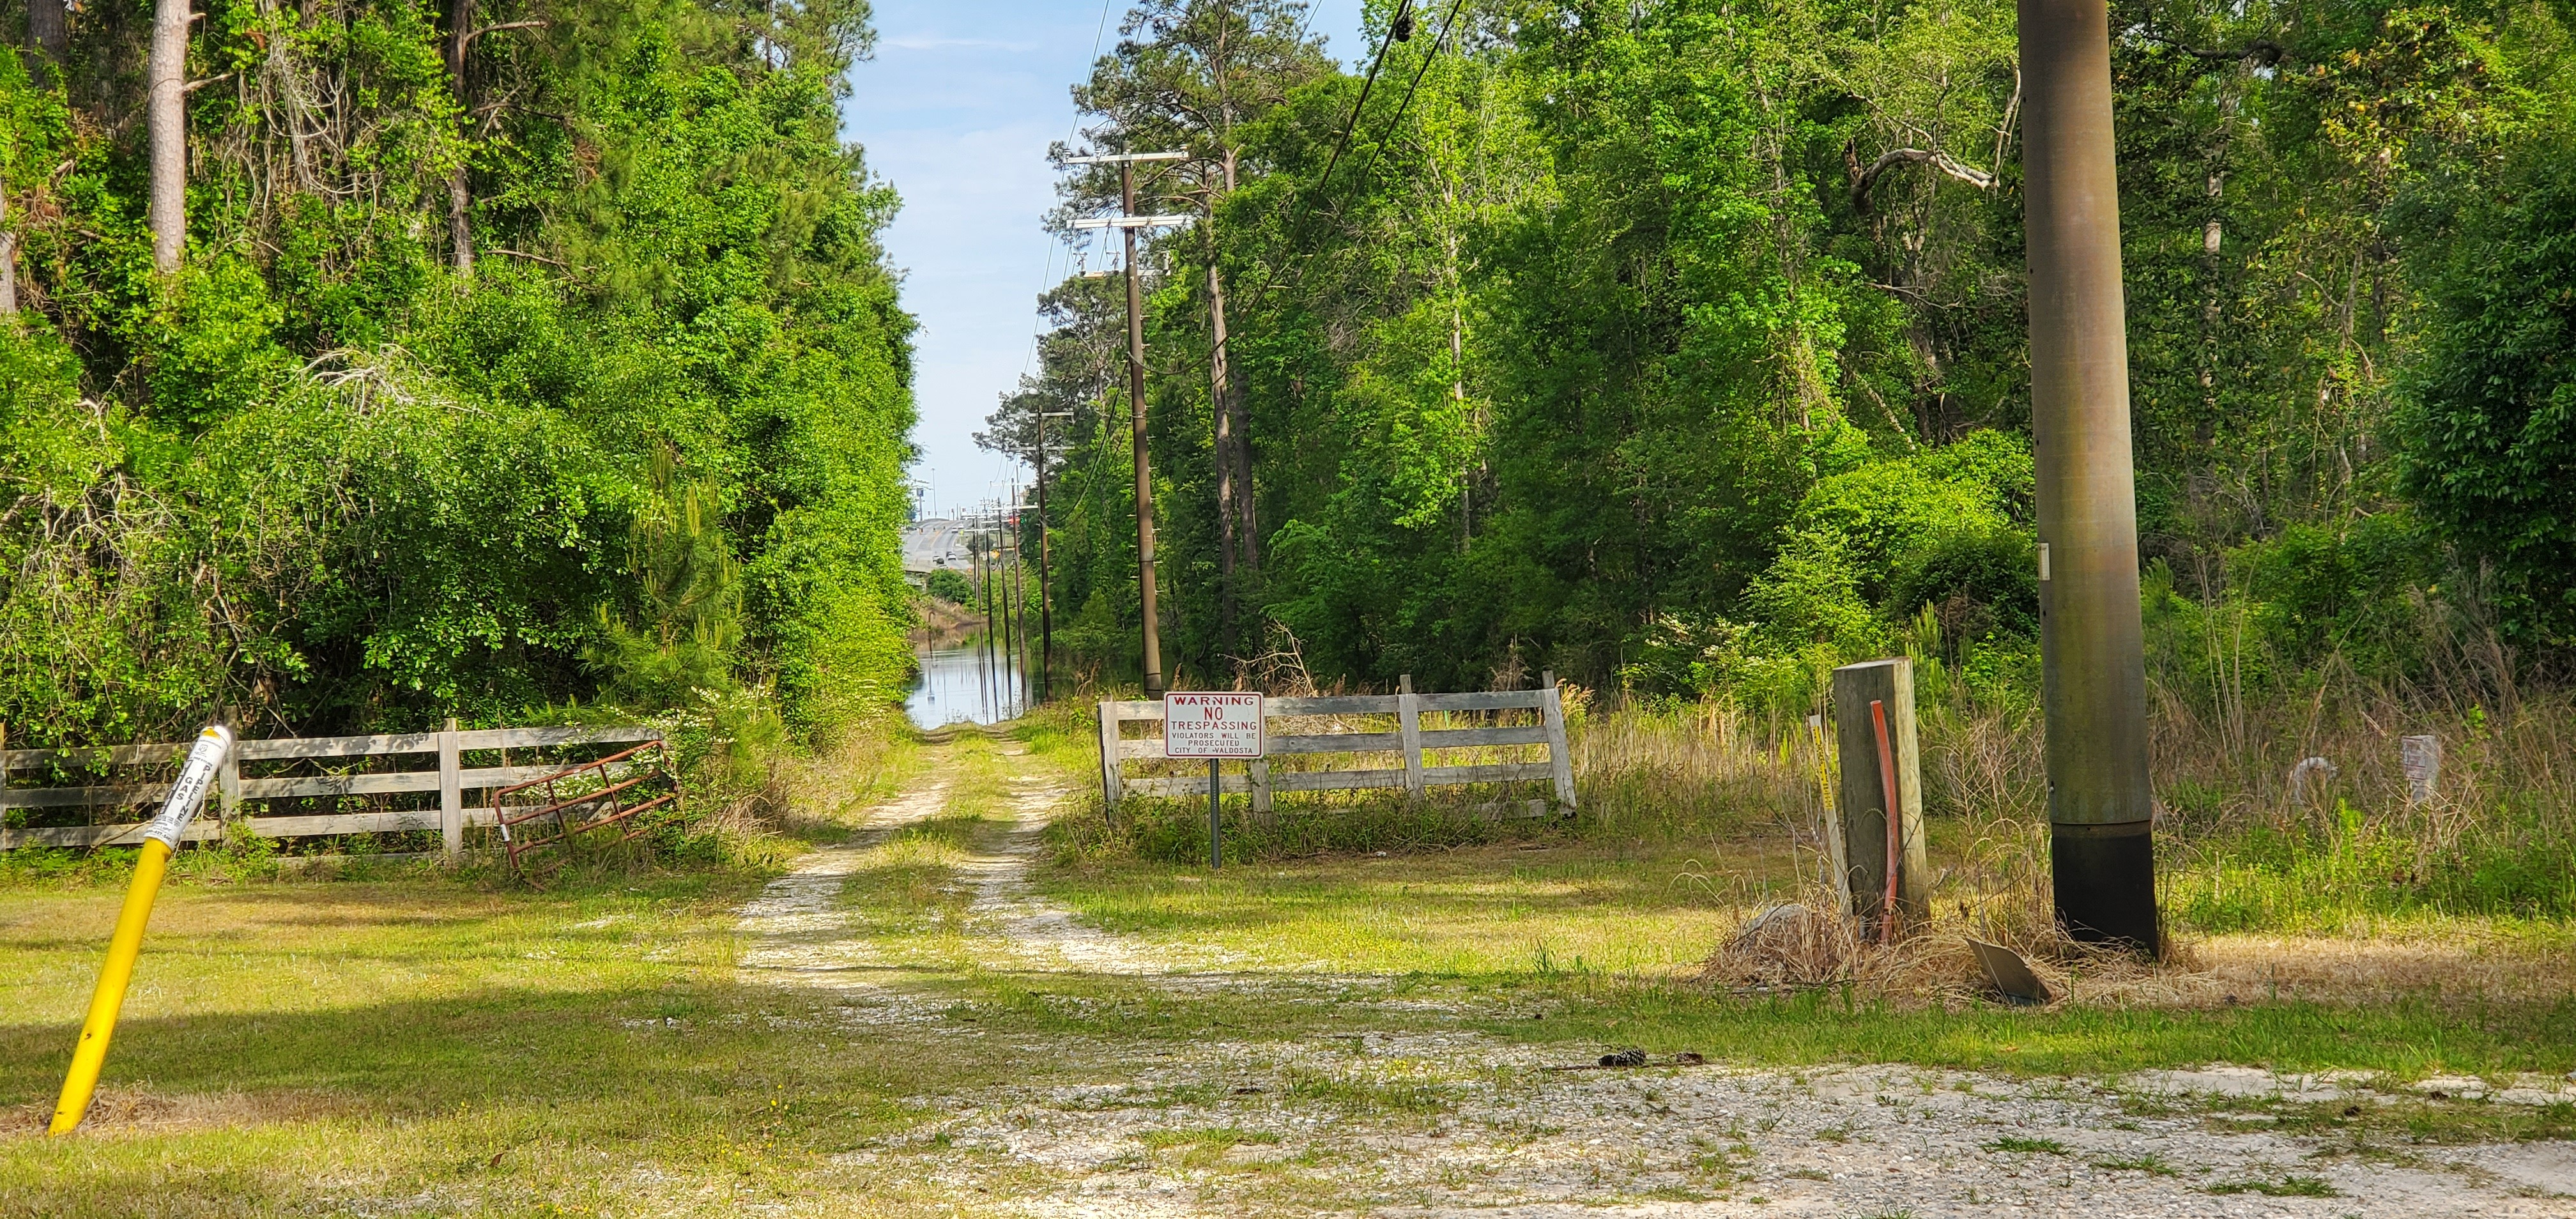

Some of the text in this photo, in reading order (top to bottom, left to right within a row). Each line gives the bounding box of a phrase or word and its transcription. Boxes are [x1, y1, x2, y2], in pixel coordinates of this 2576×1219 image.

[1174, 696, 1254, 705] WARNING
[1204, 707, 1223, 721] NO
[1170, 721, 1257, 730] TRESPASSING
[176, 776, 193, 801] GAS
[176, 765, 211, 822] PIPELINE
